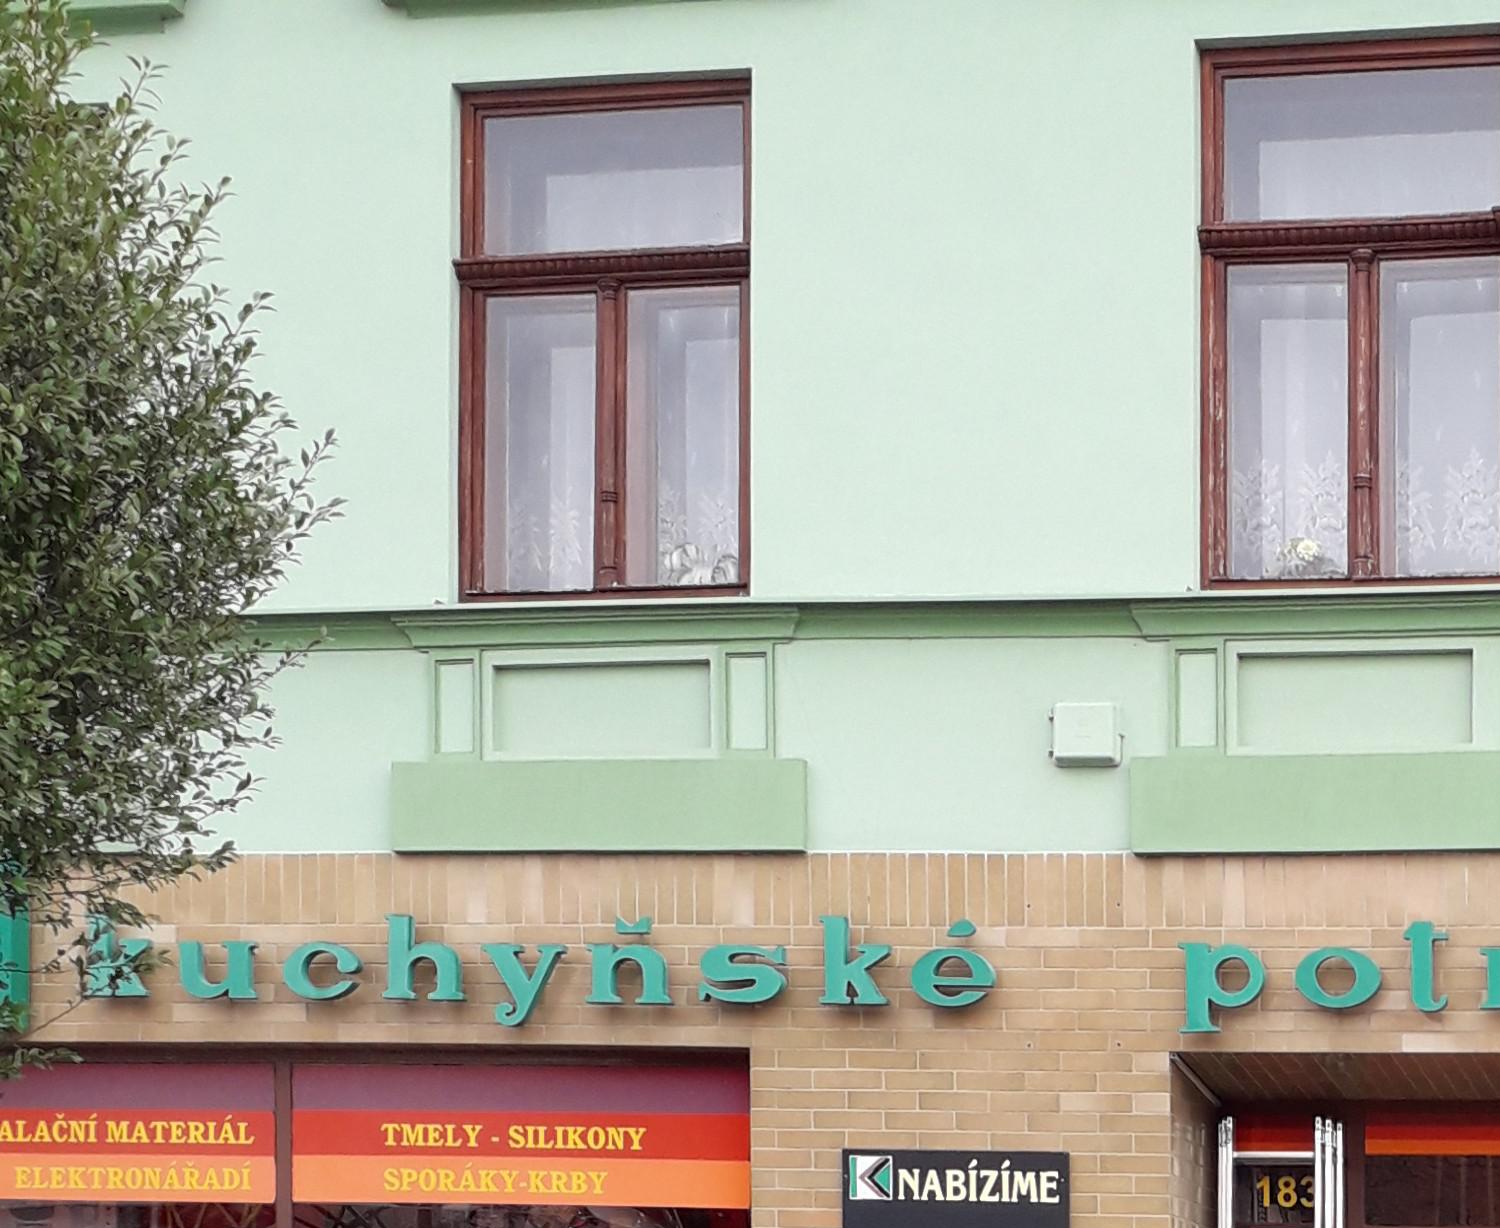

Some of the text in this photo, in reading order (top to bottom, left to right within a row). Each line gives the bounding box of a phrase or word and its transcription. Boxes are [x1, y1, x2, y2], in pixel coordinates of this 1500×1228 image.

[84, 912, 997, 1028] kuchyňské
[105, 1114, 255, 1145] MATERIÁL
[381, 1123, 483, 1148] TMELY
[508, 1124, 647, 1151] SILIKONY
[15, 1161, 253, 1191] ELEKTRONÁŘADÍ
[383, 1162, 608, 1195] SPORÁKY-KRBY
[898, 1159, 1061, 1204] NABÍZÍME
[1256, 1175, 1315, 1208] 183
